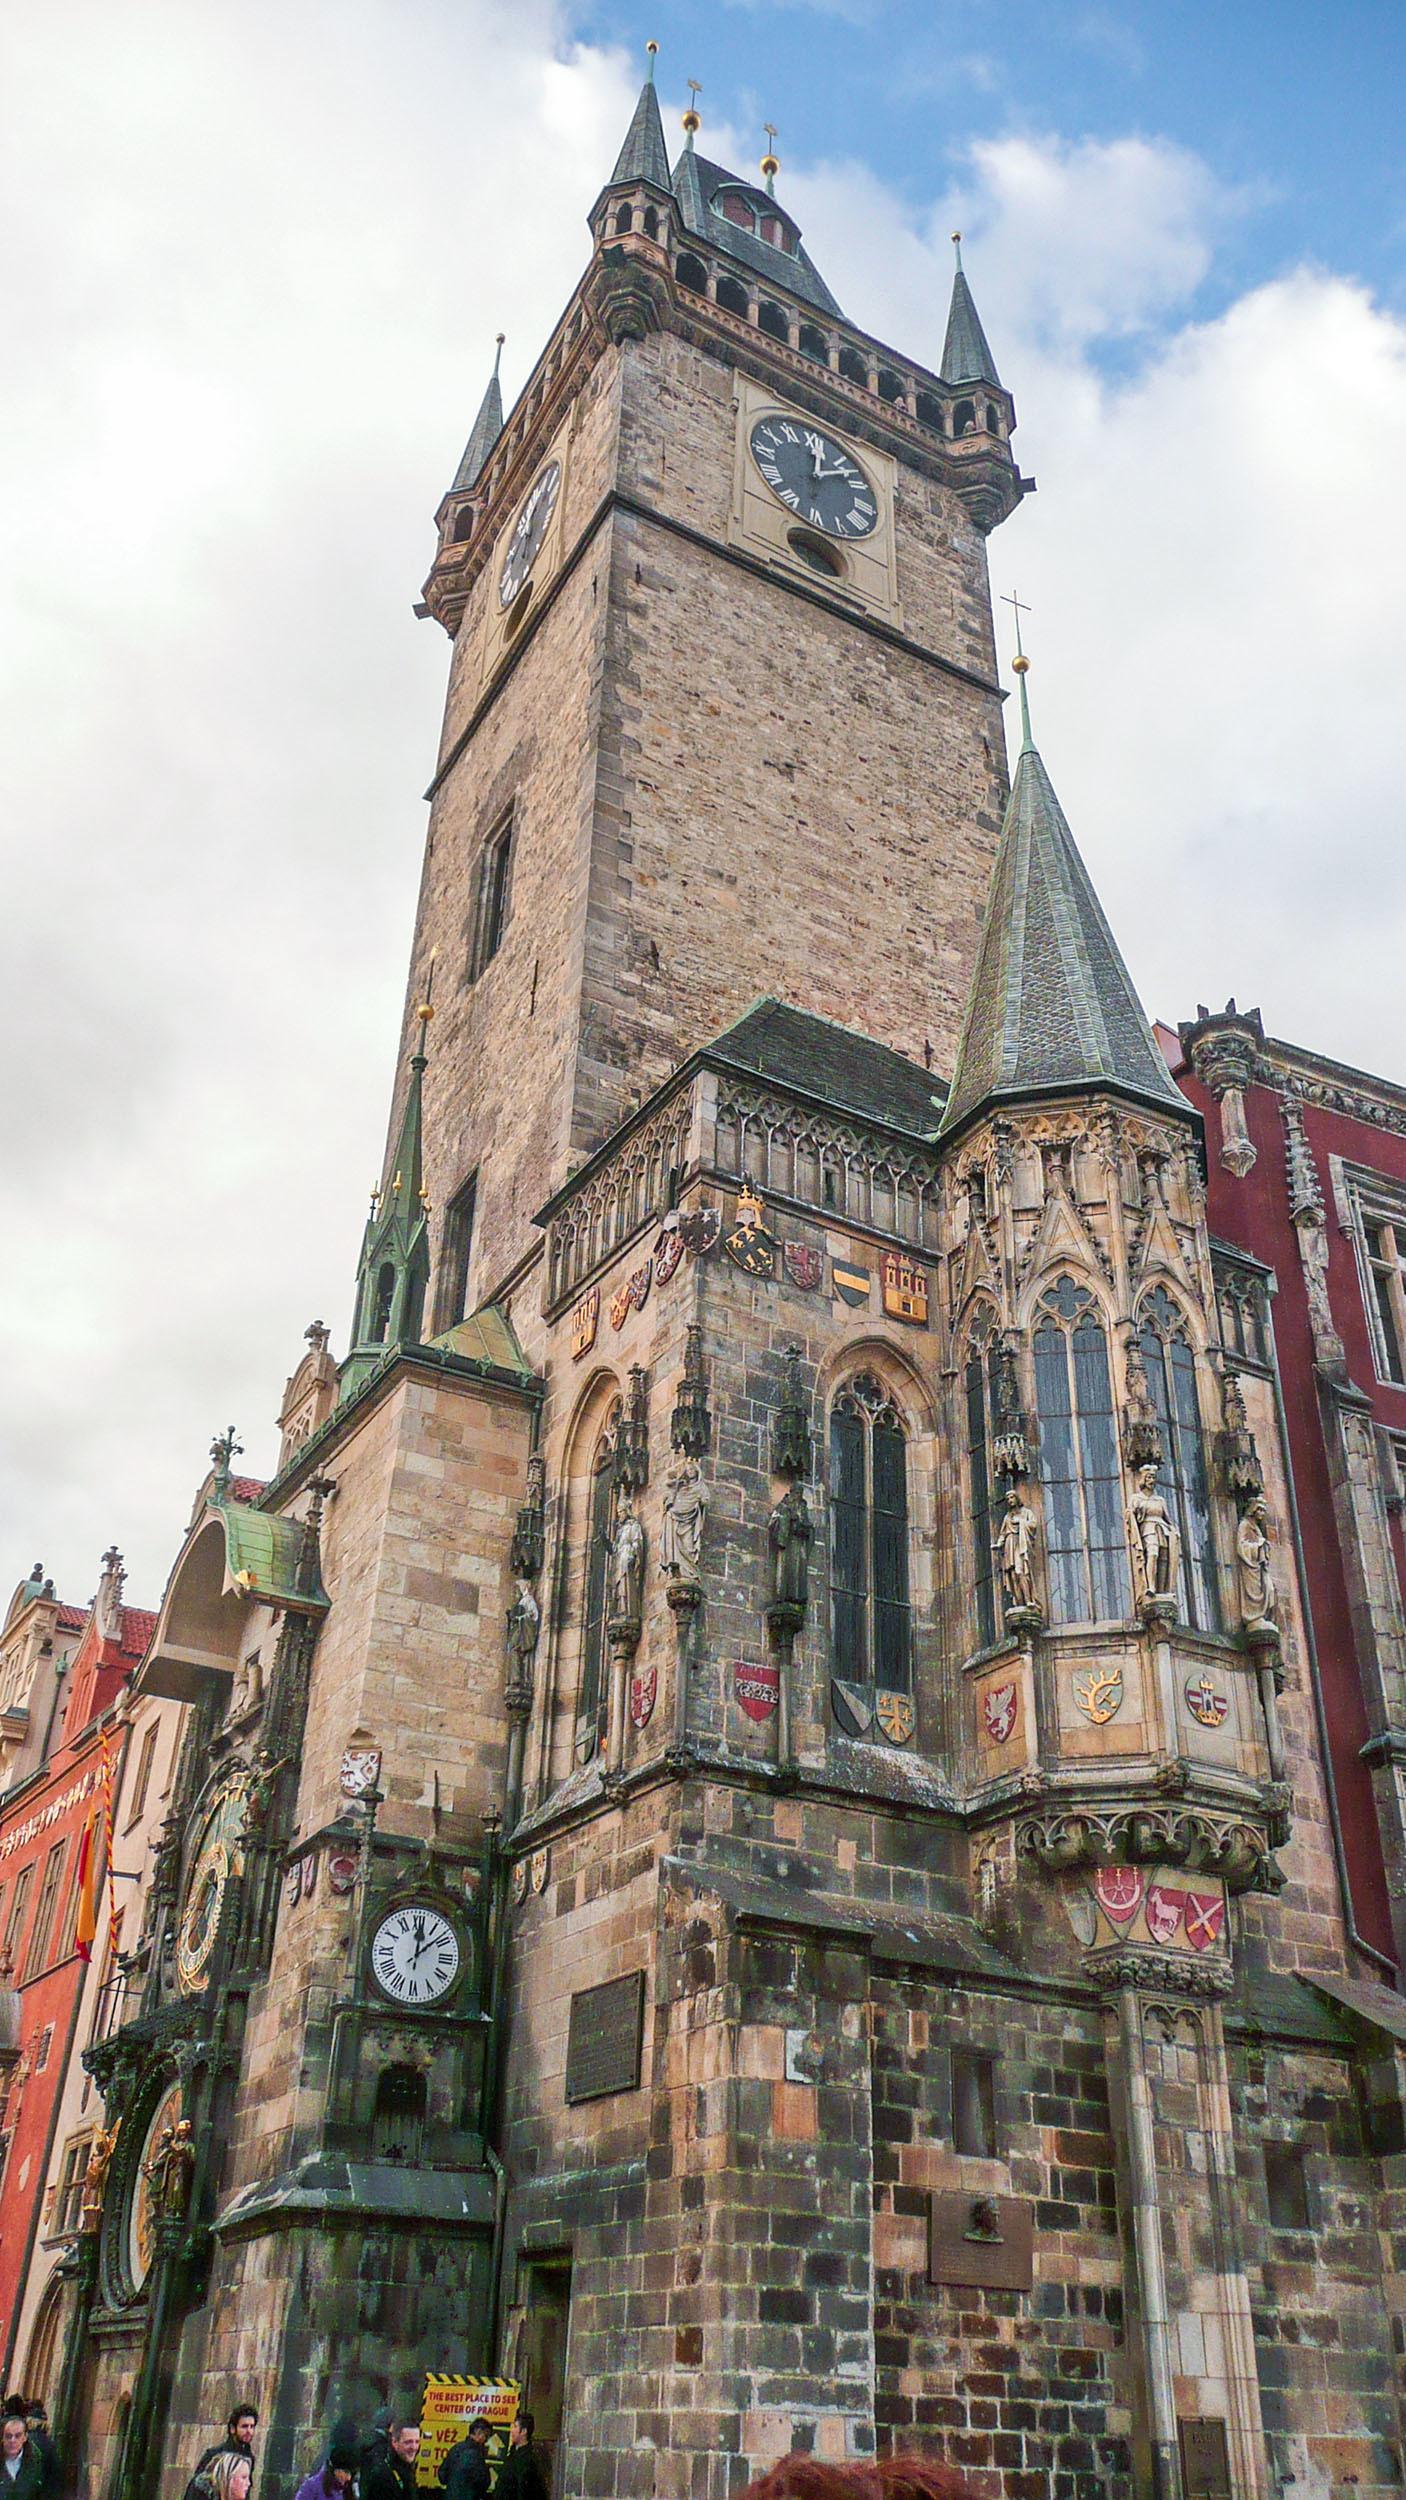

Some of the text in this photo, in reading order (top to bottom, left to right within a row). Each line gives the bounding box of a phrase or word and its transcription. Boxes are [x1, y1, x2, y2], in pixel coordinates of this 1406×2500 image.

[429, 2392, 516, 2404] THE BEST PLACE TO SEE
[434, 2404, 509, 2416] CENTER OF PRAGUE
